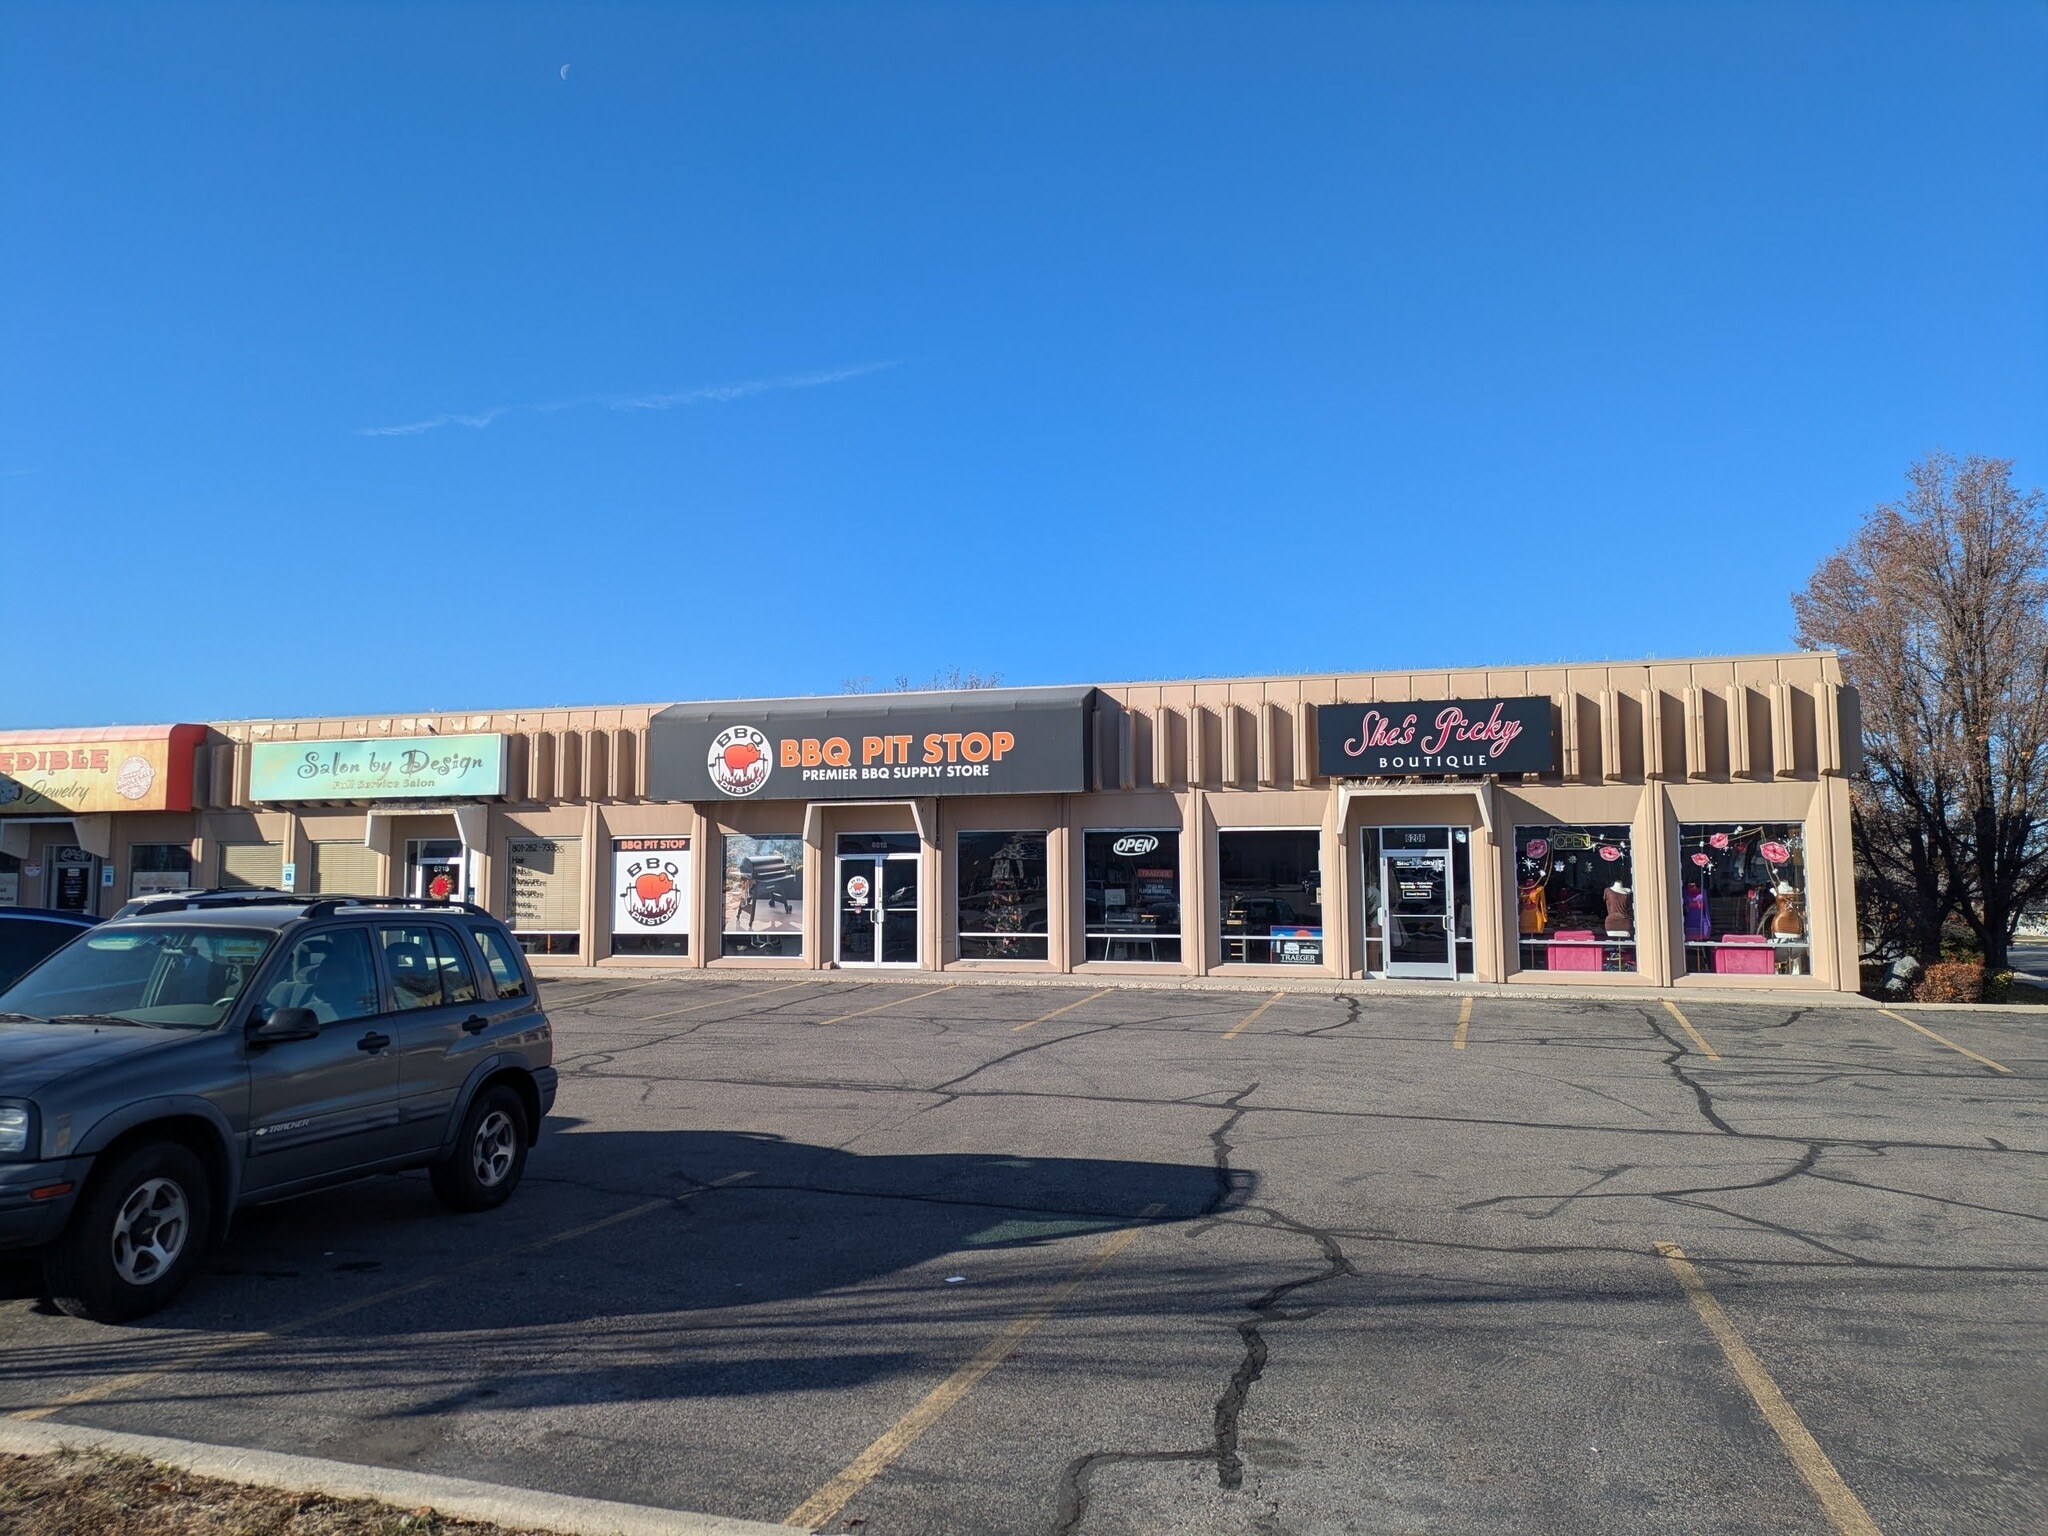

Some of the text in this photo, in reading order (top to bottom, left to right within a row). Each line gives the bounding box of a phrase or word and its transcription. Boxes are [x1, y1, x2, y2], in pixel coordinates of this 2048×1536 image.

[716, 728, 764, 748] BBQ
[1344, 702, 1523, 758] She's Picky
[780, 731, 1015, 768] BBQ PIT STOP
[297, 749, 484, 781] Salon by Design
[1379, 754, 1487, 768] BOUTIQUE
[802, 764, 989, 781] PREMIER BBQ SUPPLY STORE
[357, 779, 400, 789] Service
[402, 778, 435, 788] Salon
[720, 777, 762, 793] PITSTOP
[25, 780, 90, 804] Jewelry
[621, 839, 686, 850] BBQ PIT STOP
[1116, 838, 1153, 852] OPEN
[1556, 836, 1589, 848] OPEN
[626, 857, 679, 878] BBQ
[631, 908, 675, 925] PITSTOP
[1280, 953, 1316, 962] TRAEGER
[269, 1119, 310, 1133] TRACKER
